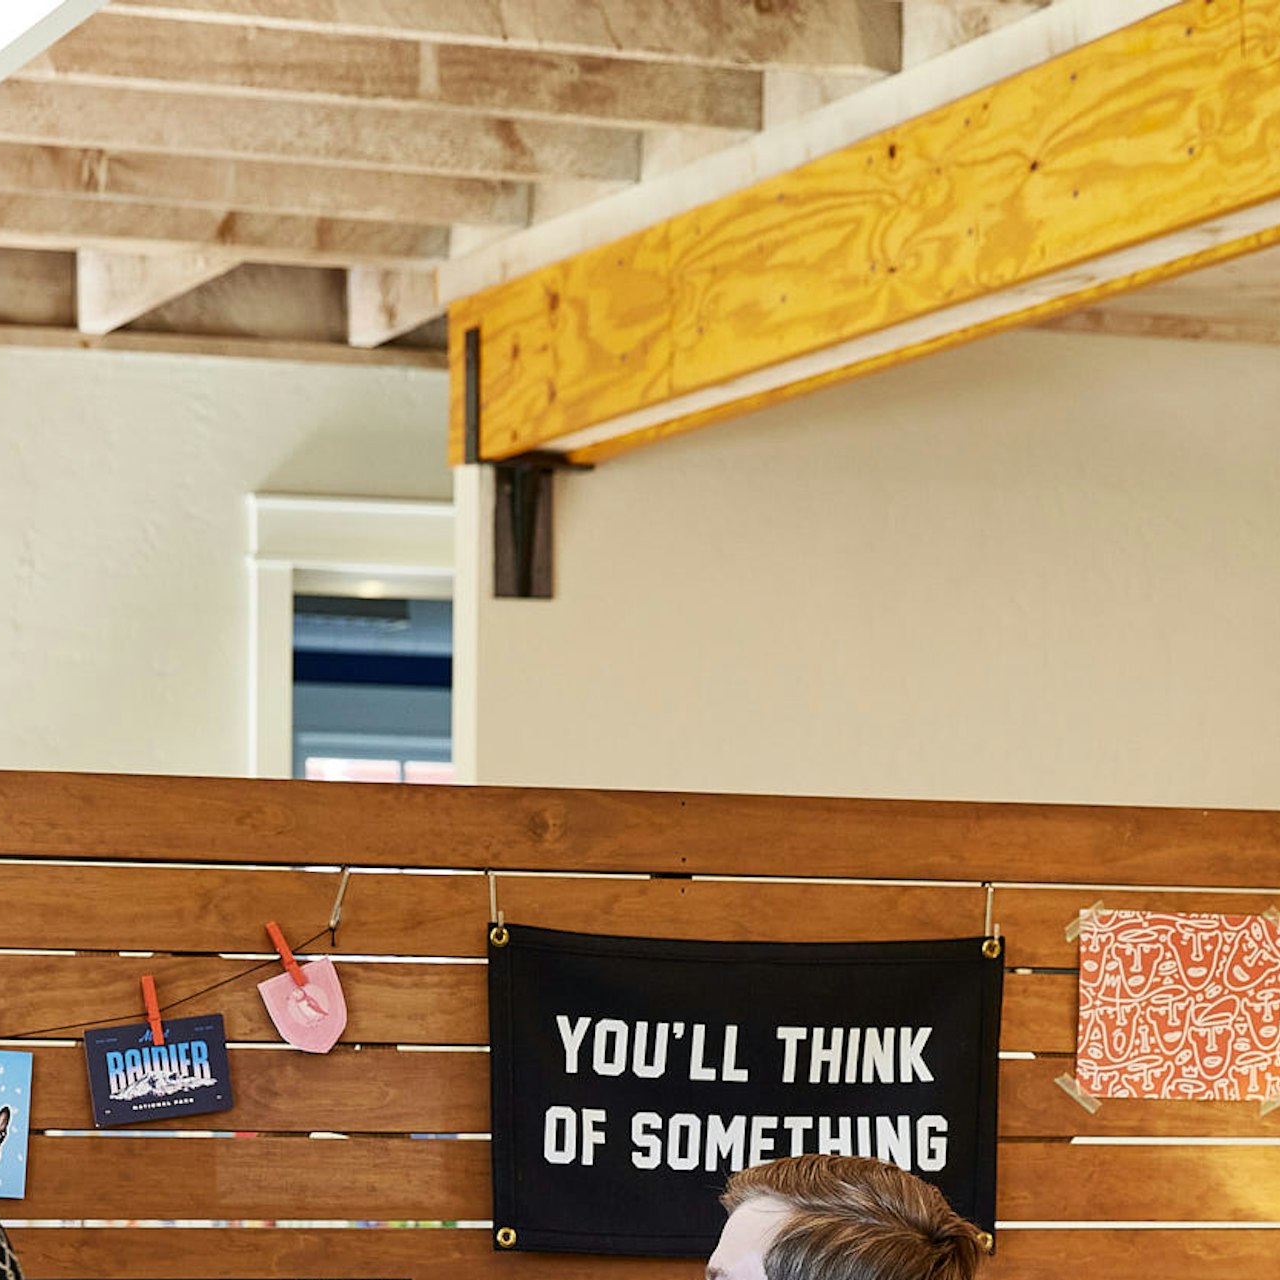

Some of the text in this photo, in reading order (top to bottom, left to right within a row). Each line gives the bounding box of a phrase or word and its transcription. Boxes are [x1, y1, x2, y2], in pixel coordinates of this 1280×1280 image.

[556, 1014, 935, 1083] YOU'LL THINK
[543, 1105, 949, 1172] OF SOMETHING
